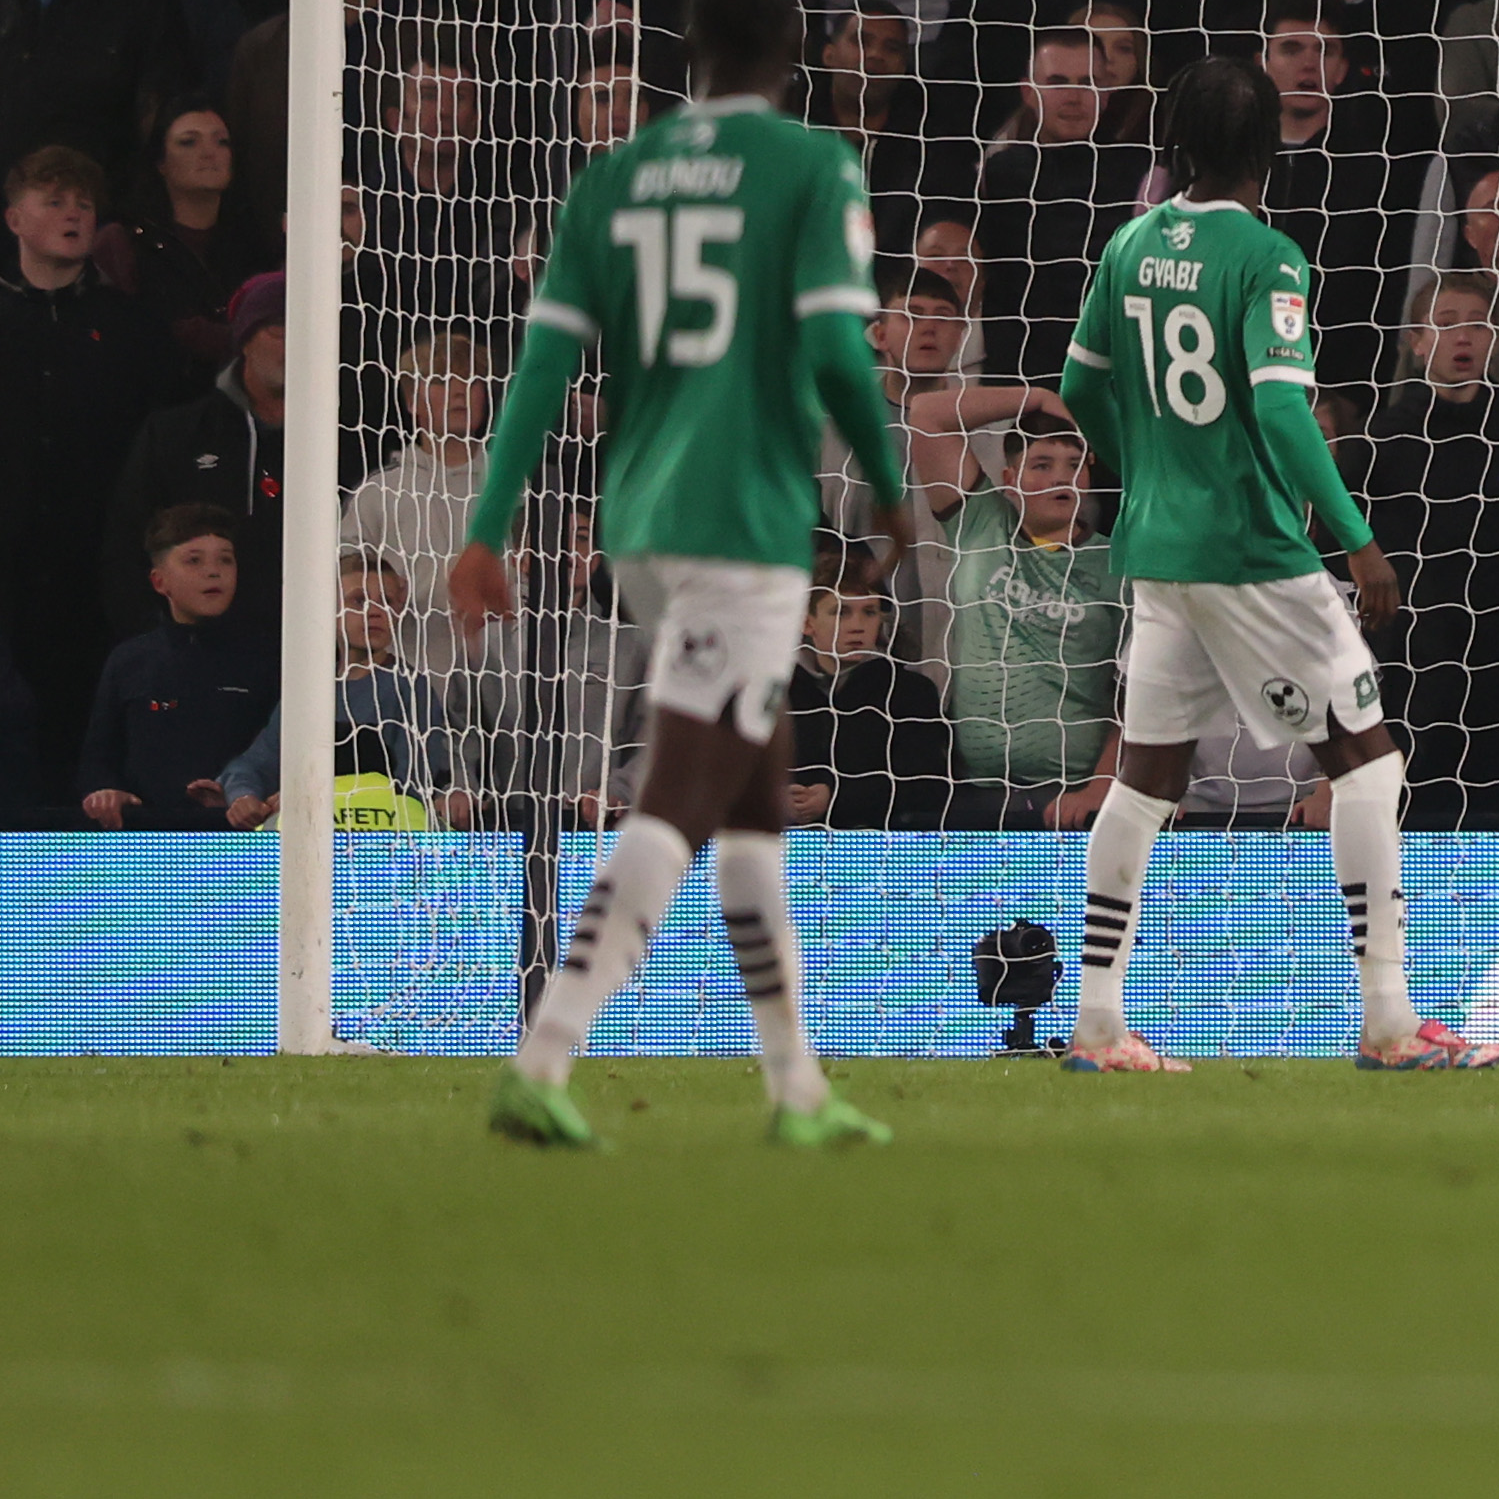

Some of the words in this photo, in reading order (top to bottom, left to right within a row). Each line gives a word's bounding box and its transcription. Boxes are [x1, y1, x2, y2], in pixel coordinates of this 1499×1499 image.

[611, 204, 745, 369] 15
[1138, 256, 1204, 292] GYABI
[1124, 294, 1227, 427] 18
[333, 807, 397, 826] AFETY
